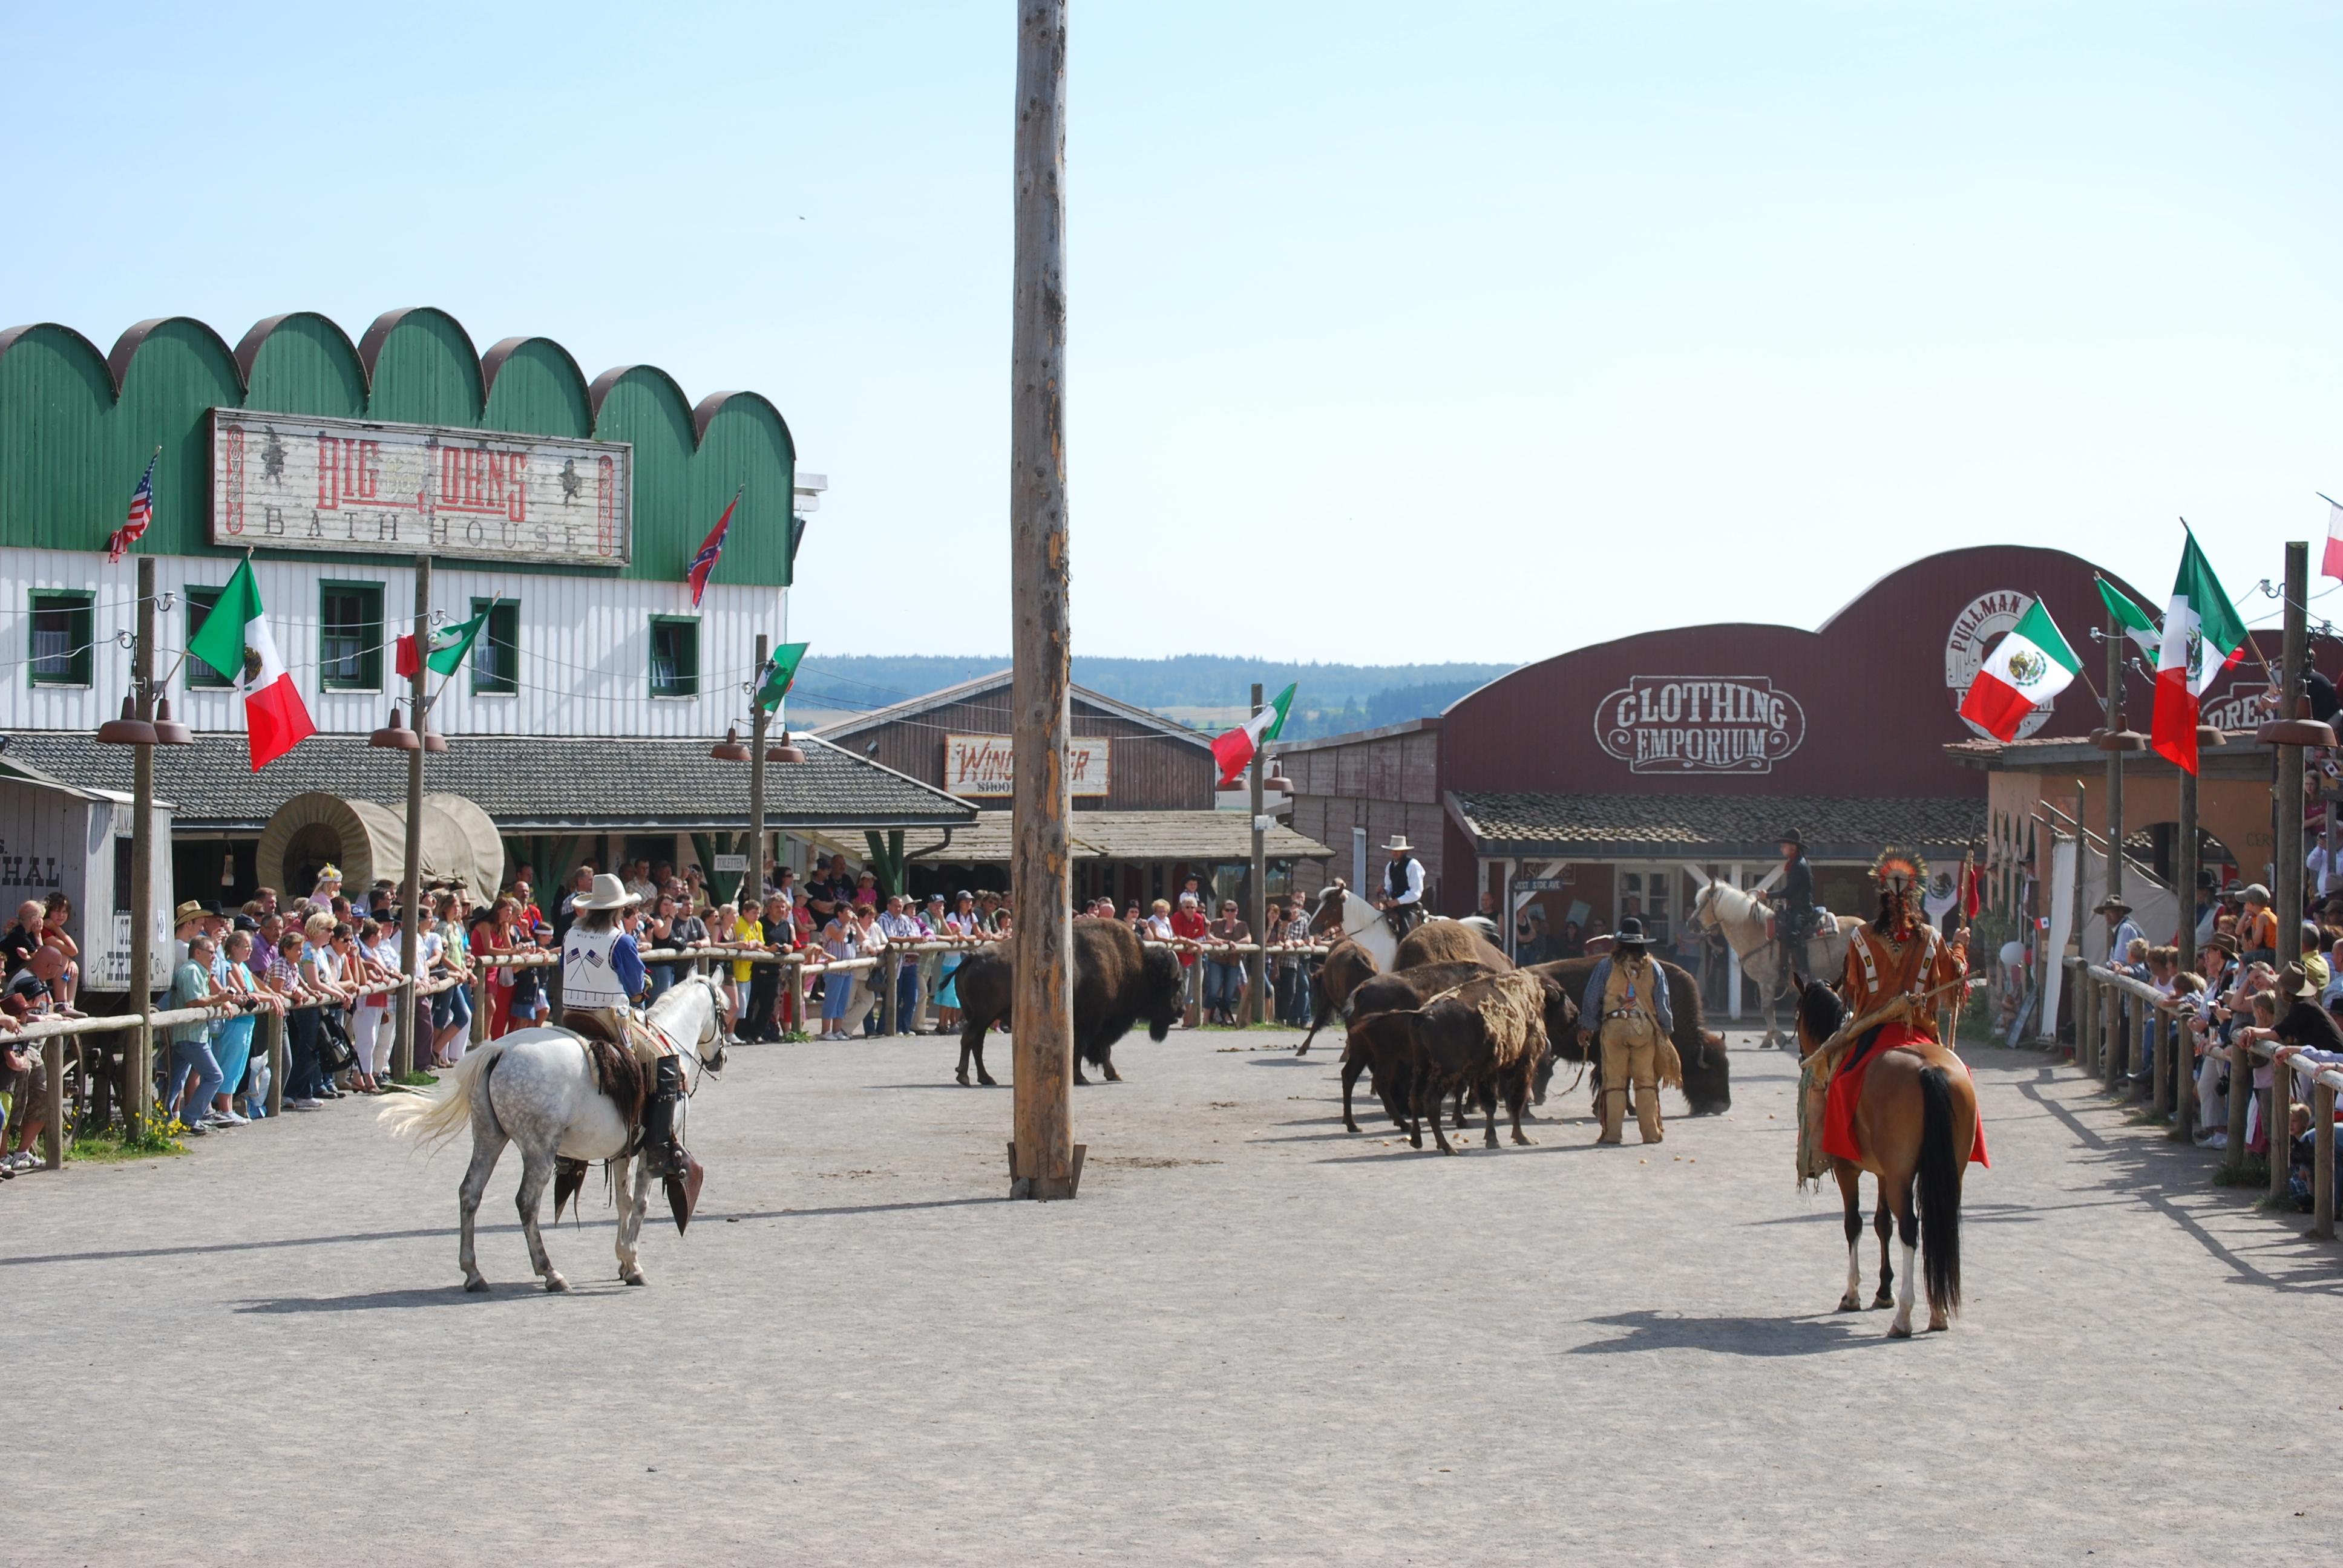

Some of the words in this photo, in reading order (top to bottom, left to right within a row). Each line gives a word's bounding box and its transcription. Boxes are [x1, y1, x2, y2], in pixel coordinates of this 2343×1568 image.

[316, 434, 380, 510] BIG
[264, 506, 399, 541] BATH
[428, 517, 580, 552] HOUSE
[1950, 594, 2023, 653] PULLMAN
[1617, 682, 1787, 730] CLOTHING
[2207, 695, 2275, 730] DRES
[1634, 728, 1768, 765] EMPORIUM
[2246, 832, 2276, 847] CERV
[0, 857, 59, 887] HAL
[1514, 881, 1529, 890] WEST
[1532, 880, 1547, 889] SIDE
[1548, 880, 1560, 889] AVE
